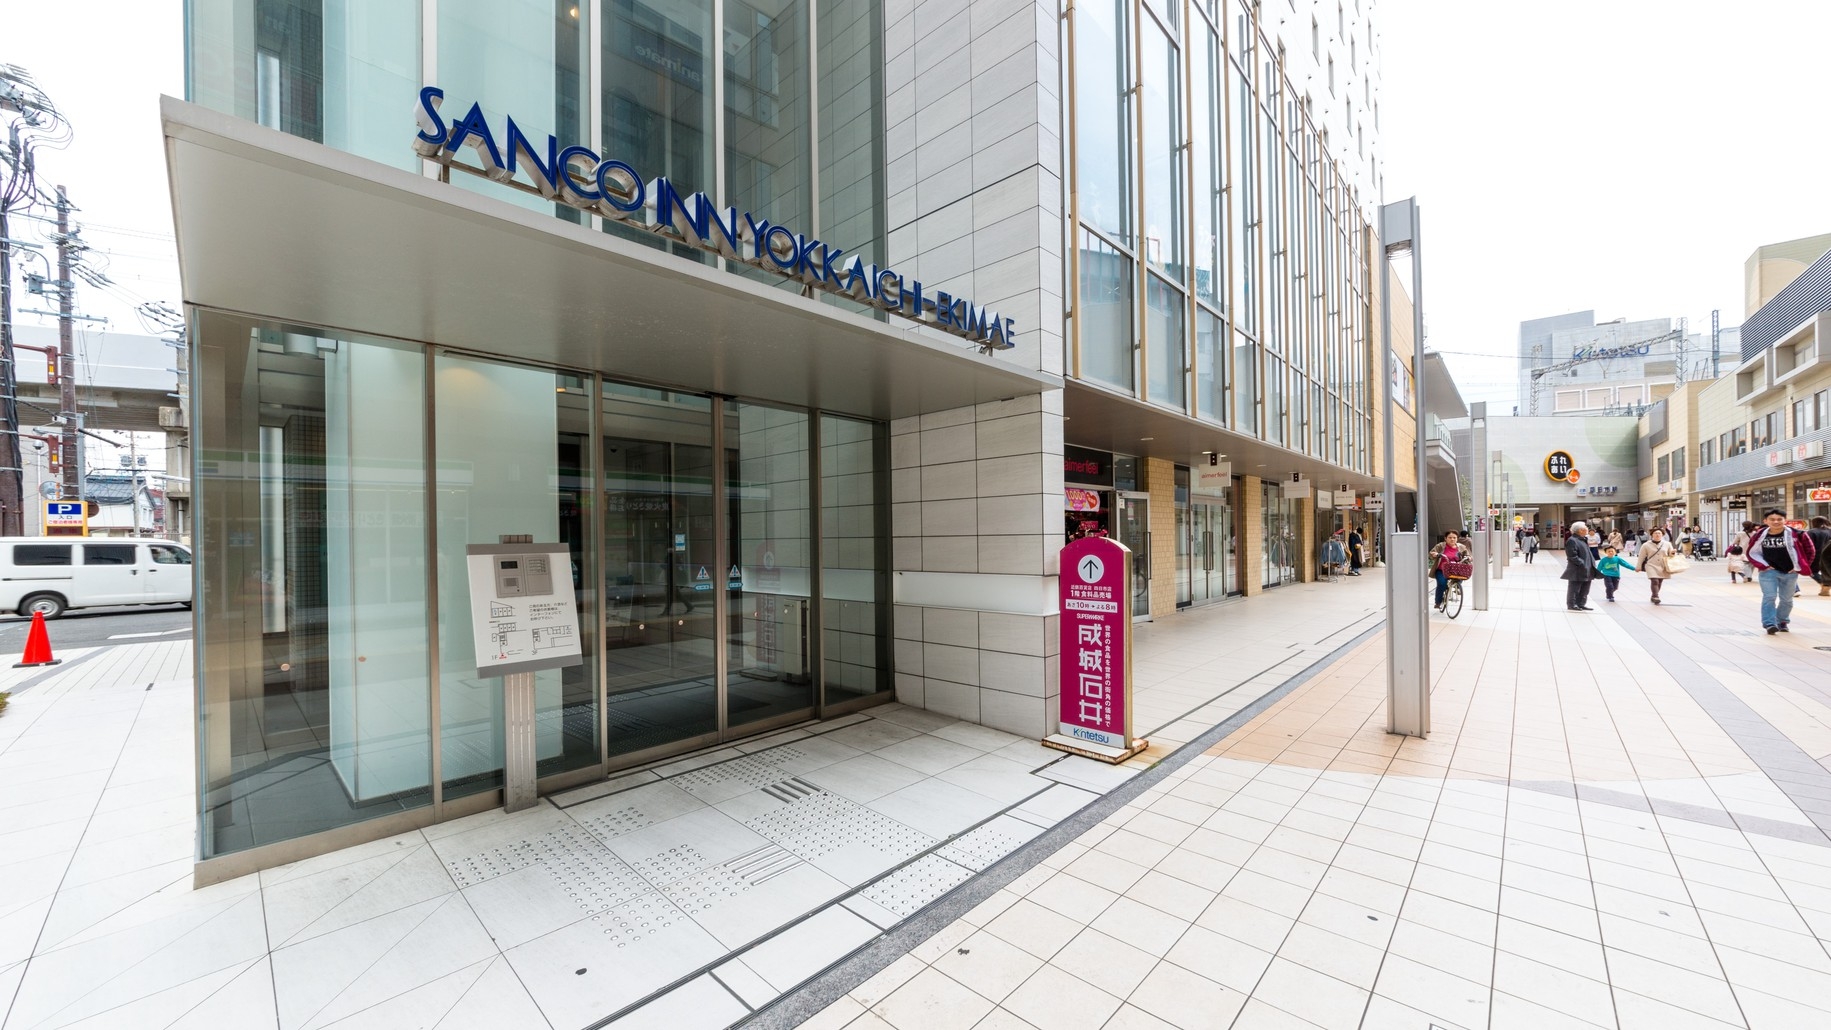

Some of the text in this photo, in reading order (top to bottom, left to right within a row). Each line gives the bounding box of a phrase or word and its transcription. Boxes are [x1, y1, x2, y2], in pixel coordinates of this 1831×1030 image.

[415, 86, 1016, 348] SANCO INN YOKKAICHI-EKIMAE
[1064, 458, 1099, 475] aimerfeel
[58, 504, 72, 514] P
[1078, 623, 1103, 725] 成城石井
[1073, 727, 1110, 744] Kintetsu
